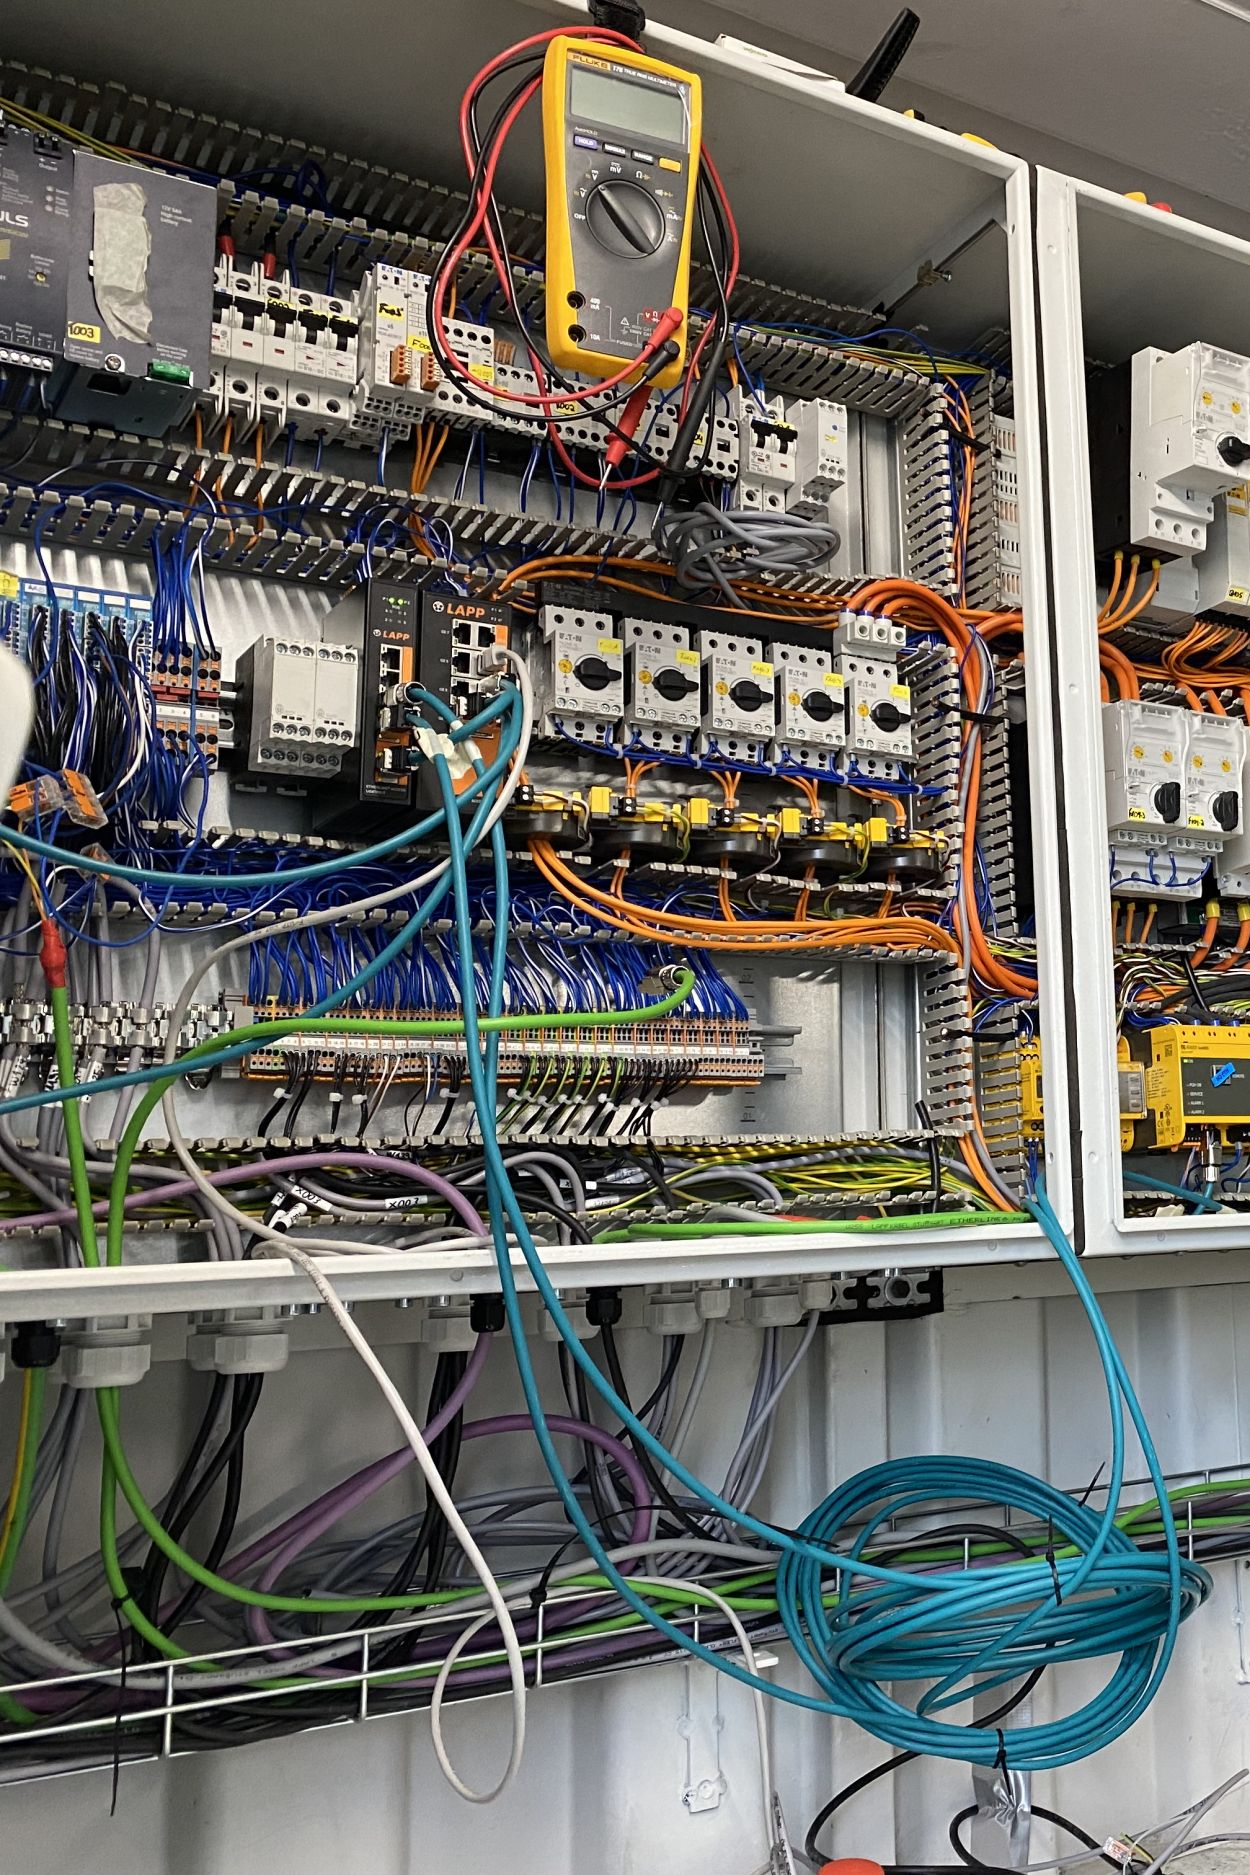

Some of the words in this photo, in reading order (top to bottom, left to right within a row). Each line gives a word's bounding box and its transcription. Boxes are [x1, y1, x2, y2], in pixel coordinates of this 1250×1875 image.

[572, 54, 608, 69] FLUKE
[579, 137, 594, 146] HOLD
[446, 602, 486, 619] LAPP
[382, 630, 411, 641] LAPP
